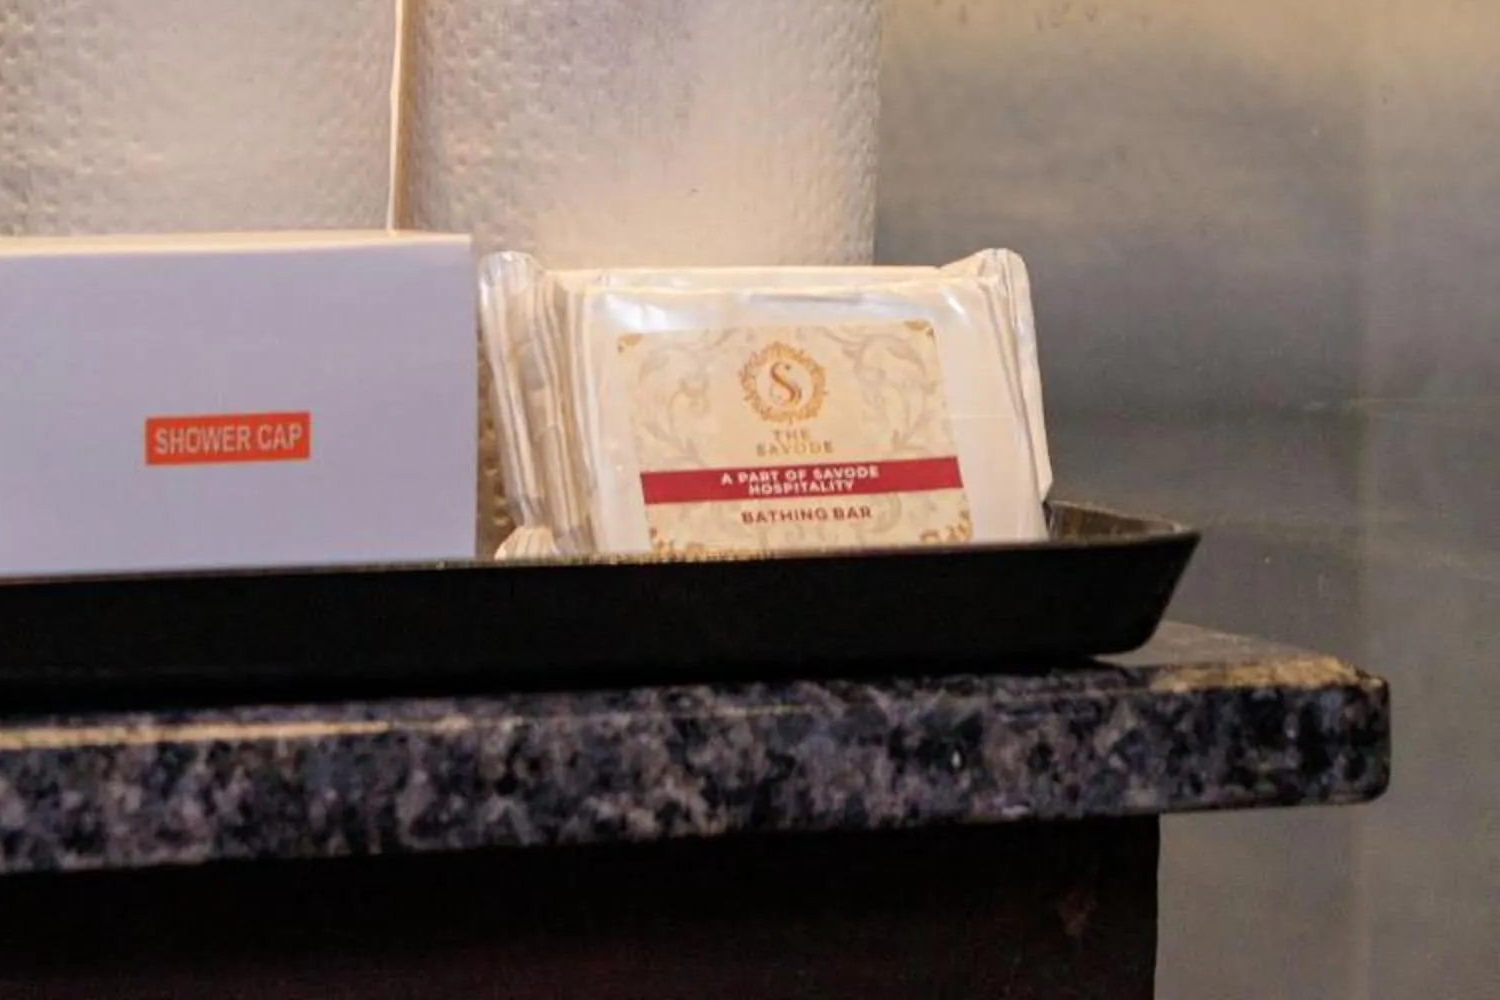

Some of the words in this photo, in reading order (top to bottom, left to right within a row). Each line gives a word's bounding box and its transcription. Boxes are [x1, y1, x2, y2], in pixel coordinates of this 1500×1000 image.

[155, 425, 251, 455] SHOWER
[257, 423, 302, 450] CAP
[773, 429, 810, 441] THE
[756, 441, 833, 457] SAVODE
[721, 473, 733, 485] A
[738, 471, 779, 484] PART
[785, 469, 807, 482] OF
[813, 466, 879, 481] SAVODE
[748, 479, 854, 495] HOSPITALITY
[742, 508, 828, 524] BATHING
[834, 505, 872, 521] BAR
